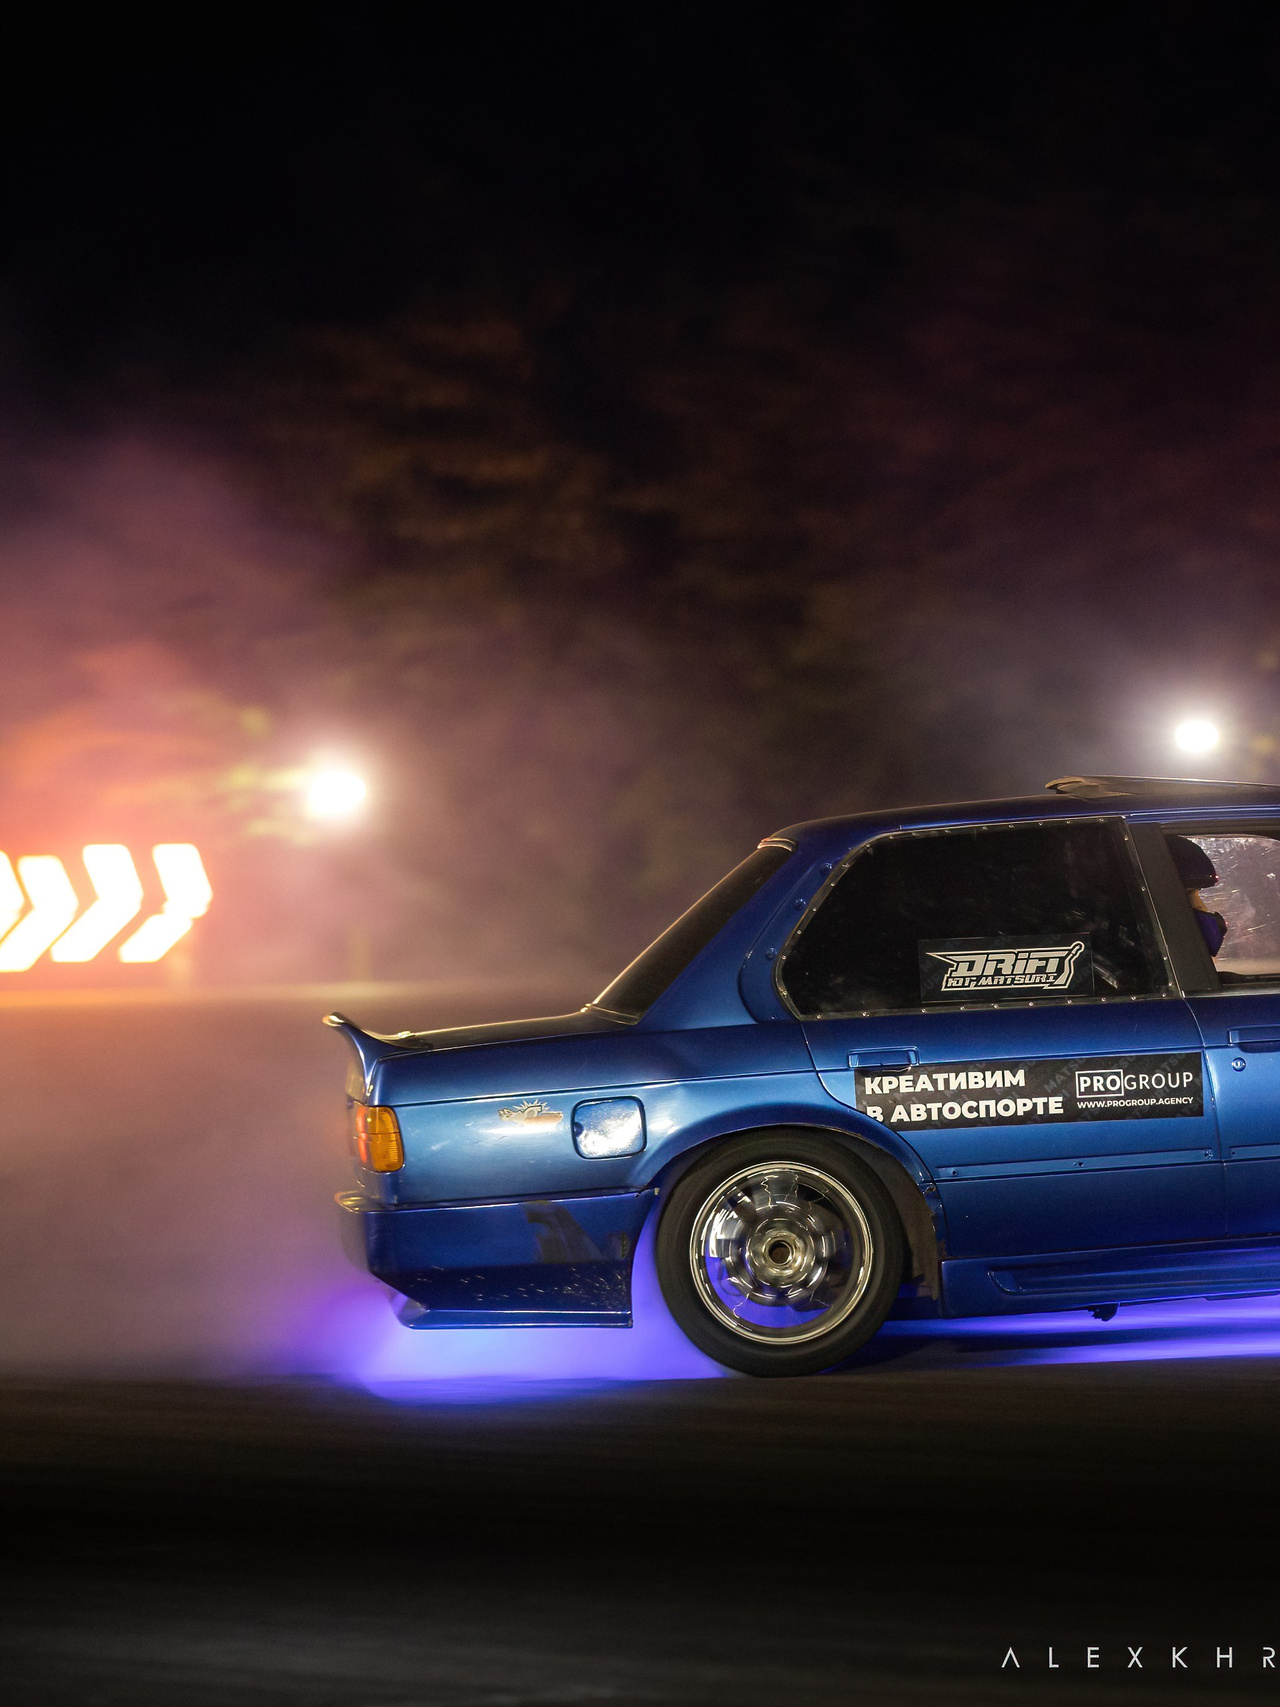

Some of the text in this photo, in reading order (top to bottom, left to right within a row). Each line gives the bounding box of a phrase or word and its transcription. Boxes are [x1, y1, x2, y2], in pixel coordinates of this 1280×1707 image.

[978, 973, 1057, 986] MATSURI
[864, 1069, 1026, 1095] КРЕАТИВИМ
[866, 1096, 1064, 1123] В АВТОСПОРТЕ
[1077, 1097, 1194, 1109] WWW.PROGROUP.AGENCY
